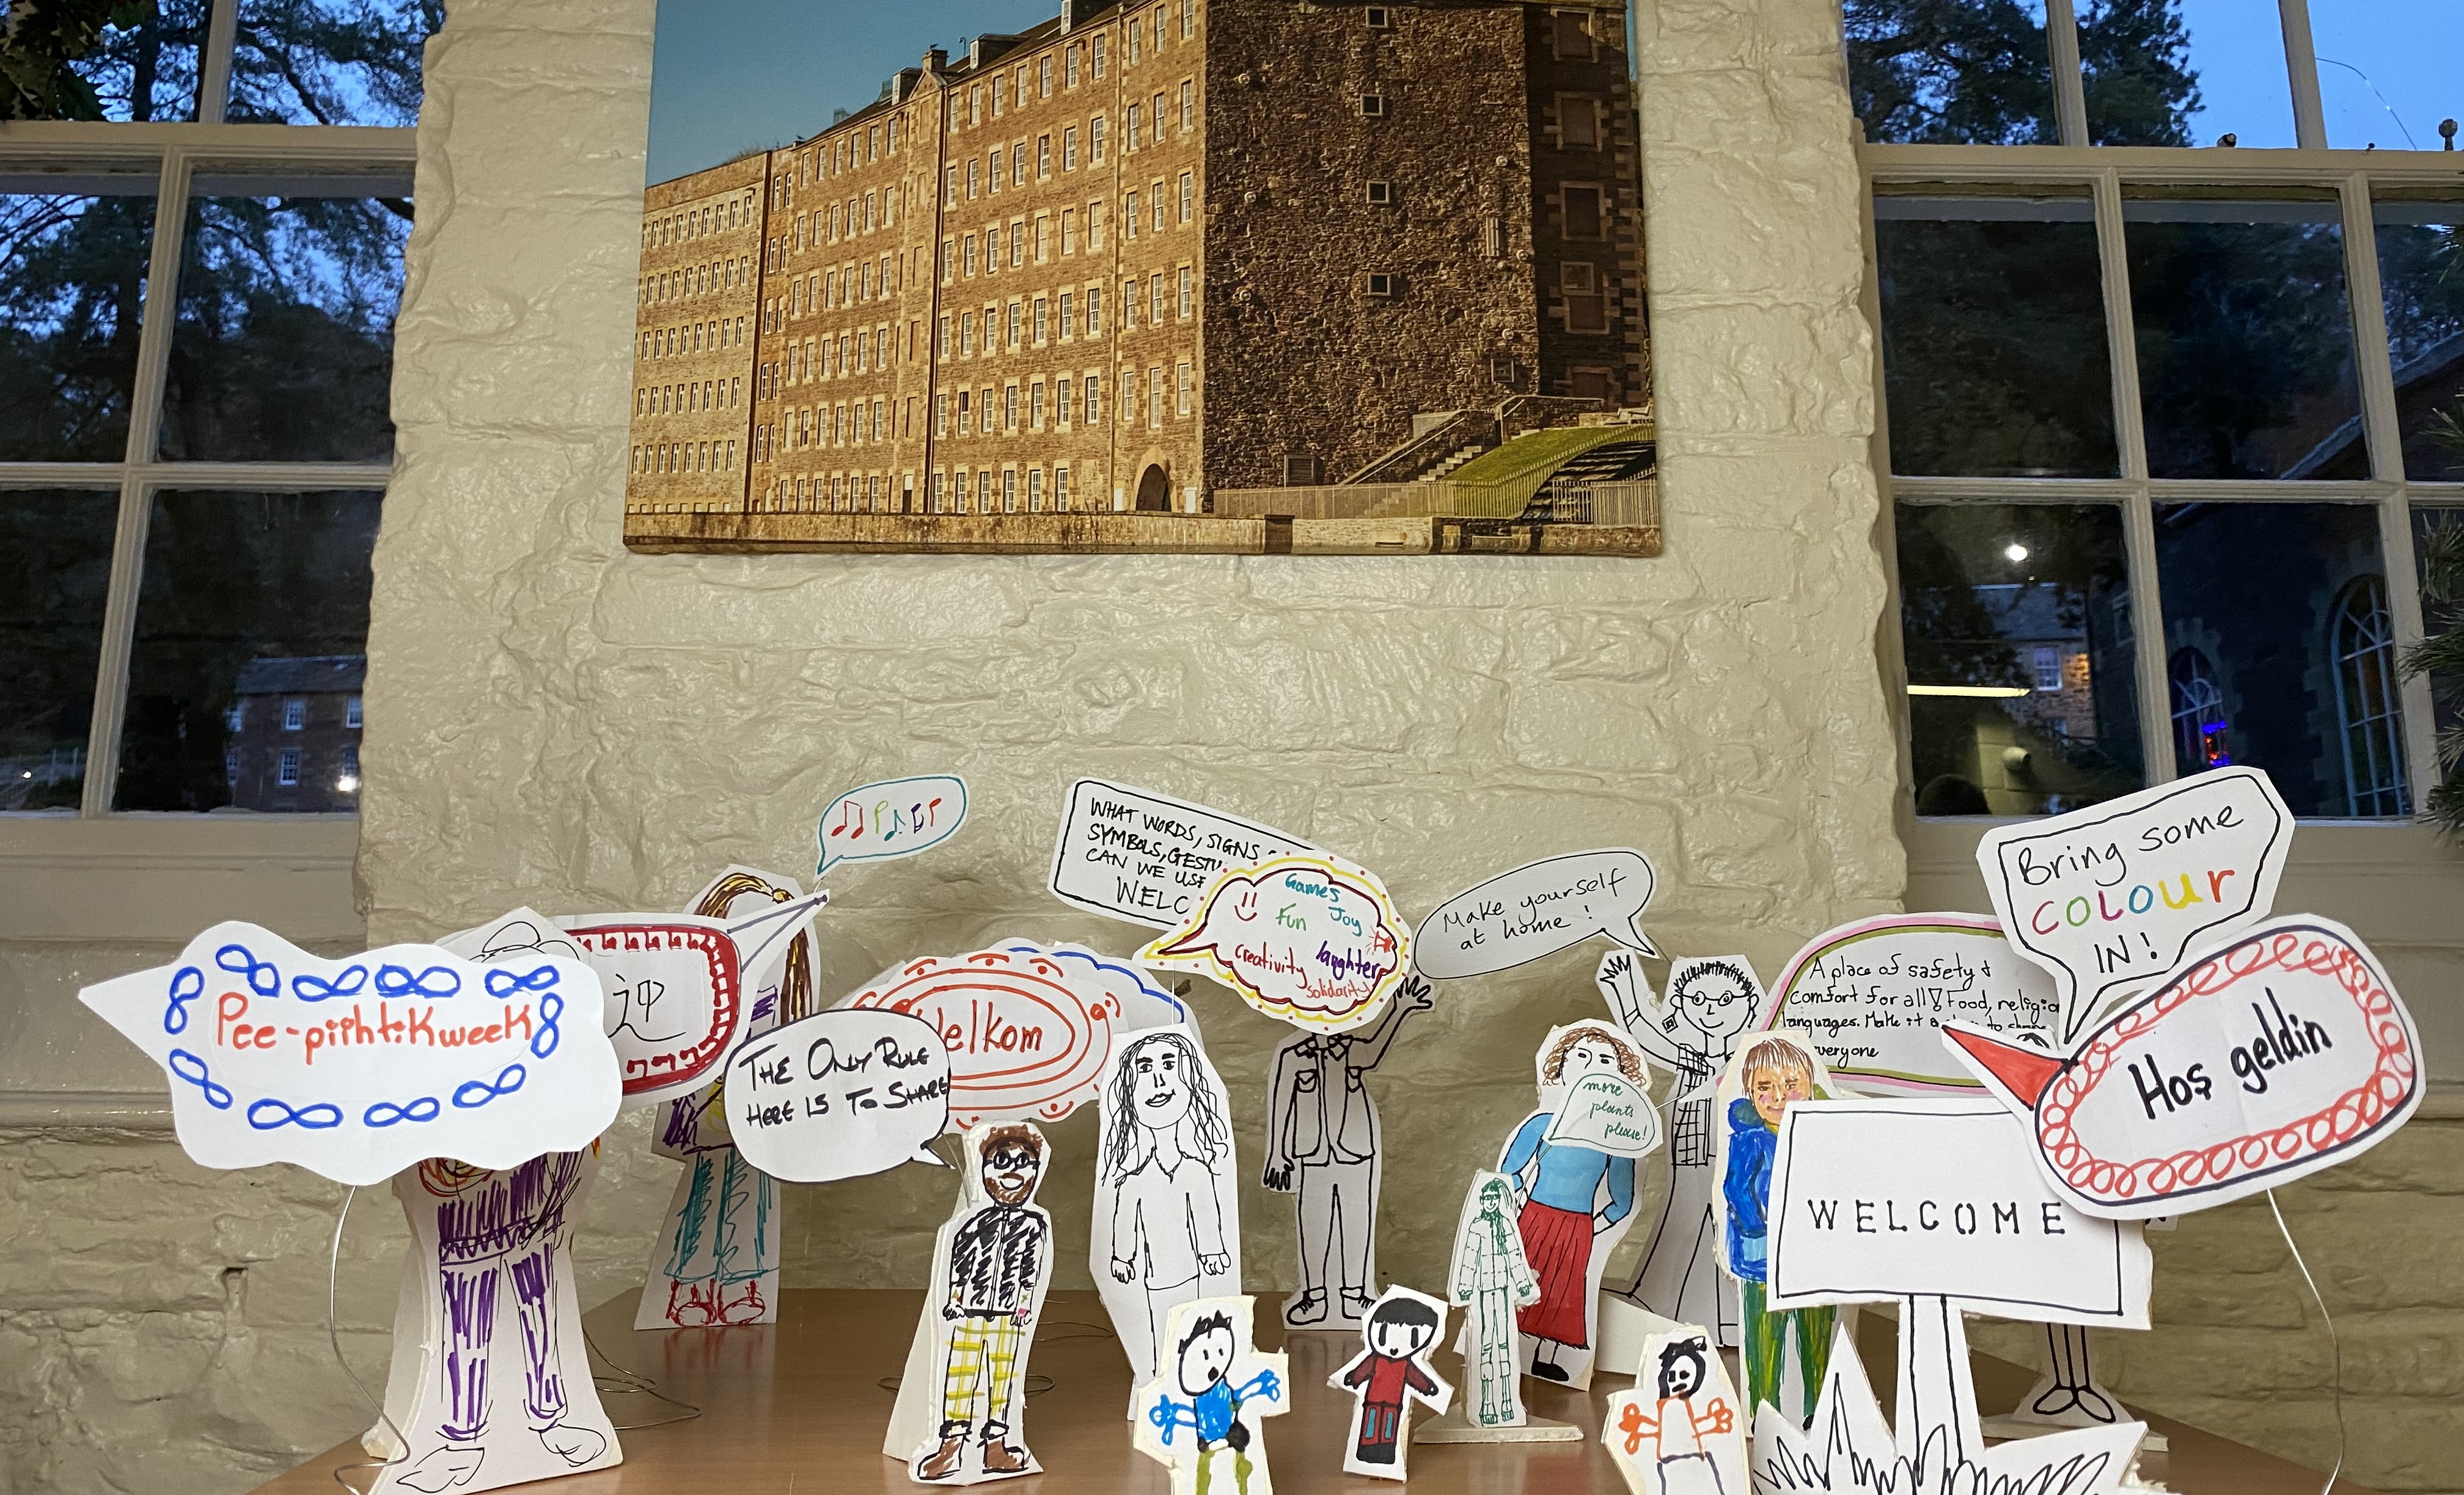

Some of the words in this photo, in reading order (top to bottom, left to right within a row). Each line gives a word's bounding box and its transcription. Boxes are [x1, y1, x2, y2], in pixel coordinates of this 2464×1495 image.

[1087, 824, 1167, 863] SYMBOLS,
[1091, 797, 1139, 824] WHAT
[1143, 813, 1203, 849] WORDS,
[1206, 833, 1260, 860] SIGNS
[2019, 843, 2127, 886] Bring
[2138, 805, 2243, 852] some
[1086, 848, 1128, 869] CAN
[1137, 862, 1166, 879] WE
[1285, 872, 1340, 902] Games
[1444, 901, 1505, 933] Make
[1519, 868, 1627, 926] yourself
[1275, 903, 1307, 931] Fun
[1328, 906, 1362, 937] Joy
[1461, 928, 1486, 951] at
[2094, 932, 2158, 973] IN!
[1316, 940, 1381, 981] laughter
[1810, 956, 1826, 979] A
[1832, 955, 1871, 987] place
[1879, 953, 1902, 976] of
[1909, 953, 1976, 991] safety
[1306, 978, 1371, 999] solidarity
[1865, 985, 1898, 1006] for
[1781, 1011, 1860, 1038] languages.
[1906, 1012, 1923, 1027] it
[1987, 1015, 2003, 1031] to
[2231, 987, 2332, 1094] geldin
[1583, 1082, 1624, 1096] more
[1589, 1100, 1634, 1119] plants
[1807, 1199, 2065, 1234] WELCOME
